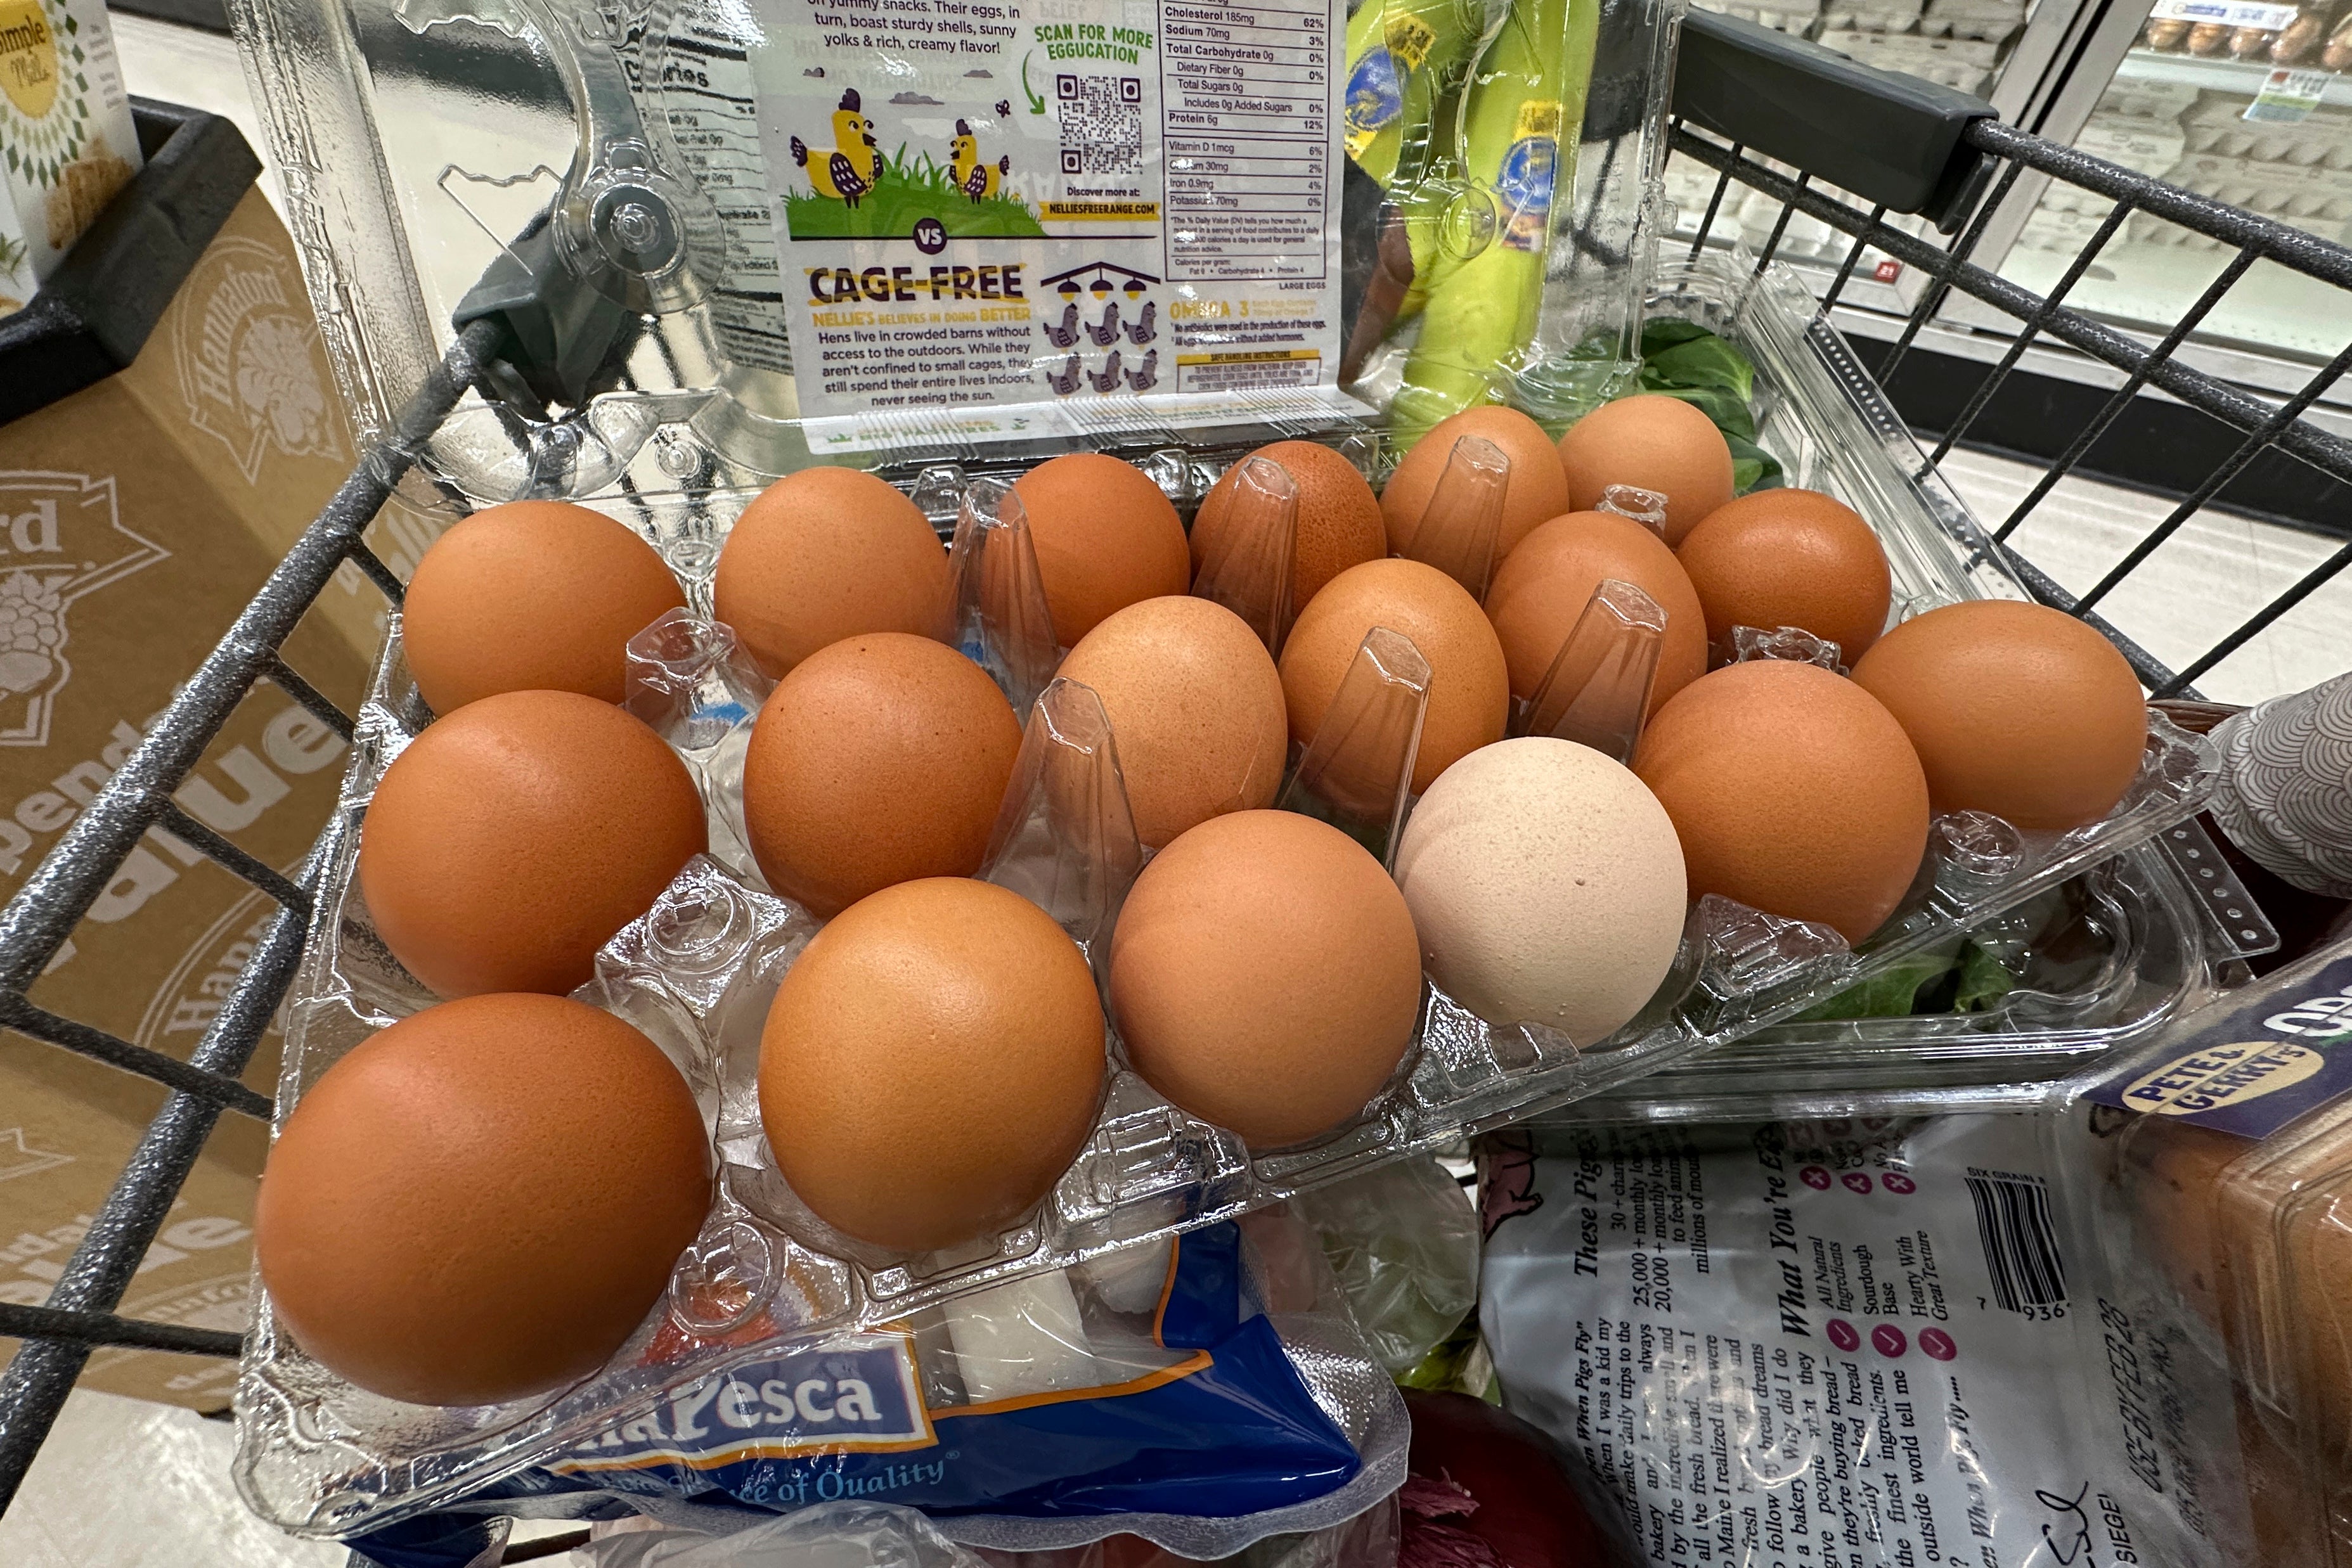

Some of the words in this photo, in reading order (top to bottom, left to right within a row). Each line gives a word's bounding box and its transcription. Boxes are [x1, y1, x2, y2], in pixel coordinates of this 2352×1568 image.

[815, 13, 847, 29] turn,
[850, 15, 888, 29] boast
[892, 18, 933, 33] sturdy
[938, 20, 976, 35] shells,
[980, 24, 1016, 38] sunny
[883, 1, 931, 13] snacks.
[934, 1, 967, 14] Their
[972, 6, 1005, 20] eggs,
[1009, 6, 1020, 18] in
[1165, 6, 1222, 21] Cholesterol
[1226, 12, 1255, 25] 185mg
[1303, 18, 1324, 29] 62%
[0, 14, 46, 55] imple
[824, 33, 859, 48] yolks
[863, 35, 872, 46] &
[877, 35, 905, 51] rich,
[908, 39, 956, 53] creamy
[960, 39, 1000, 55] flavor!
[1035, 23, 1073, 42] SCAN
[1078, 24, 1106, 41] FOR
[1113, 27, 1153, 49] MORE
[1166, 24, 1203, 37] Sodium
[1206, 27, 1230, 40] 70mg
[1309, 36, 1324, 46] 3%
[1047, 42, 1139, 65] EGGUCATION
[1167, 43, 1192, 55] Total
[1196, 45, 1261, 60] Carbohydrate
[1309, 53, 1324, 63] 0%
[1177, 61, 1207, 75] Dietary
[1210, 64, 1231, 75] Fiber
[1309, 71, 1324, 81] 0%
[1178, 79, 1199, 89] Total
[1201, 80, 1230, 93] Sugars
[1169, 113, 1205, 124] Protein
[1304, 120, 1323, 130] 12%
[1184, 97, 1220, 109] Includes
[1234, 100, 1262, 111] Added
[1263, 101, 1293, 113] Sugars
[1309, 104, 1323, 113] 0%
[1168, 141, 1201, 151] Vitamin
[1212, 143, 1234, 154] 1mcg
[1206, 161, 1229, 172] 30mg
[1049, 203, 1155, 215] NELLIESFREERANGE.COM
[1067, 187, 1103, 197] Discover
[917, 228, 943, 246] VS
[810, 265, 1023, 303] CAGE-FREE
[813, 311, 875, 328] NELLIE'S
[878, 312, 926, 325] BELIEVES
[929, 312, 941, 323] IN
[945, 311, 976, 323] DOING
[980, 307, 1031, 322] BETTER
[818, 331, 851, 344] Hens
[855, 331, 876, 342] live
[879, 330, 891, 342] in
[893, 328, 948, 342] crowded
[951, 328, 984, 340] barns
[986, 325, 1031, 338] without
[823, 349, 865, 361] access
[868, 347, 882, 359] to
[884, 346, 905, 358] the
[908, 344, 966, 357] outdoors.
[968, 343, 1002, 355] While
[1005, 342, 1031, 354] they
[822, 364, 860, 378] aren't
[863, 363, 916, 376] confined
[919, 363, 932, 373] to
[935, 360, 966, 372] small
[968, 360, 1006, 371] cages,
[825, 381, 848, 394] still
[850, 380, 888, 394] spend
[891, 378, 919, 390] their
[922, 377, 956, 389] entire
[959, 375, 985, 387] lives
[988, 373, 1035, 385] indoors,
[871, 395, 905, 407] never
[908, 393, 947, 406] seeing
[950, 392, 969, 402] the
[971, 392, 995, 401] sun.
[2128, 1058, 2228, 1102] PETE
[2208, 1049, 2245, 1059] &
[2172, 1046, 2306, 1110] GERRY'S
[1966, 1166, 1989, 1179] SIX
[1611, 1211, 1627, 1231] 30
[1629, 1178, 1648, 1235] monthly
[1648, 1180, 1668, 1239] monthly
[1667, 1193, 1685, 1224] feed
[1762, 1175, 1799, 1255] You're
[1573, 1207, 1599, 1278] These
[1690, 1212, 1710, 1275] millions
[1894, 1235, 1916, 1268] With
[1916, 1230, 1940, 1280] Texture
[1807, 1235, 1832, 1285] Natural
[1829, 1240, 1855, 1314] Ingredients
[1631, 1252, 1650, 1308] 25,000
[1652, 1257, 1674, 1313] 20,000
[1852, 1243, 1880, 1316] Sourdough
[1906, 1269, 1929, 1318] Hearty
[1777, 1259, 1811, 1338] What
[1882, 1281, 1901, 1316] Base
[1926, 1281, 1949, 1322] Great
[2022, 1303, 2071, 1321] 936
[1575, 1320, 1593, 1356] Fly"
[1596, 1316, 1613, 1342] my
[1617, 1320, 1632, 1344] the
[1594, 1347, 1611, 1372] kid
[1640, 1323, 1655, 1374] always
[1771, 1346, 1789, 1369] do
[1575, 1358, 1594, 1392] Pigs
[1617, 1366, 1635, 1400] trips
[1751, 1342, 1769, 1399] dreams
[1797, 1351, 1816, 1385] they
[1840, 1360, 1864, 1408] bread
[1892, 1368, 1910, 1396] me
[1597, 1391, 1611, 1420] was
[1777, 1394, 1795, 1417] did
[1819, 1369, 1843, 1417] bread
[1576, 1395, 1592, 1441] When
[1757, 1404, 1774, 1451] bread
[1893, 1401, 1916, 1430] tell
[1597, 1443, 1619, 1485] When
[1710, 1417, 1729, 1485] realized
[1828, 1420, 1850, 1482] buying
[1900, 1434, 1927, 1485] world
[2123, 1423, 2163, 1494] USE
[777, 1474, 809, 1501] of
[1620, 1449, 1638, 1495] make
[1688, 1453, 1707, 1497] fresh
[1667, 1498, 1684, 1526] the
[1788, 1477, 1809, 1536] bakery
[1881, 1472, 1908, 1526] finest
[1648, 1504, 1665, 1562] bakery
[1716, 1498, 1736, 1558] Maine
[1764, 1492, 1786, 1555] follow
[1837, 1485, 1861, 1548] they're
[1911, 1492, 1941, 1562] outside
[1692, 1538, 1711, 1562] all
